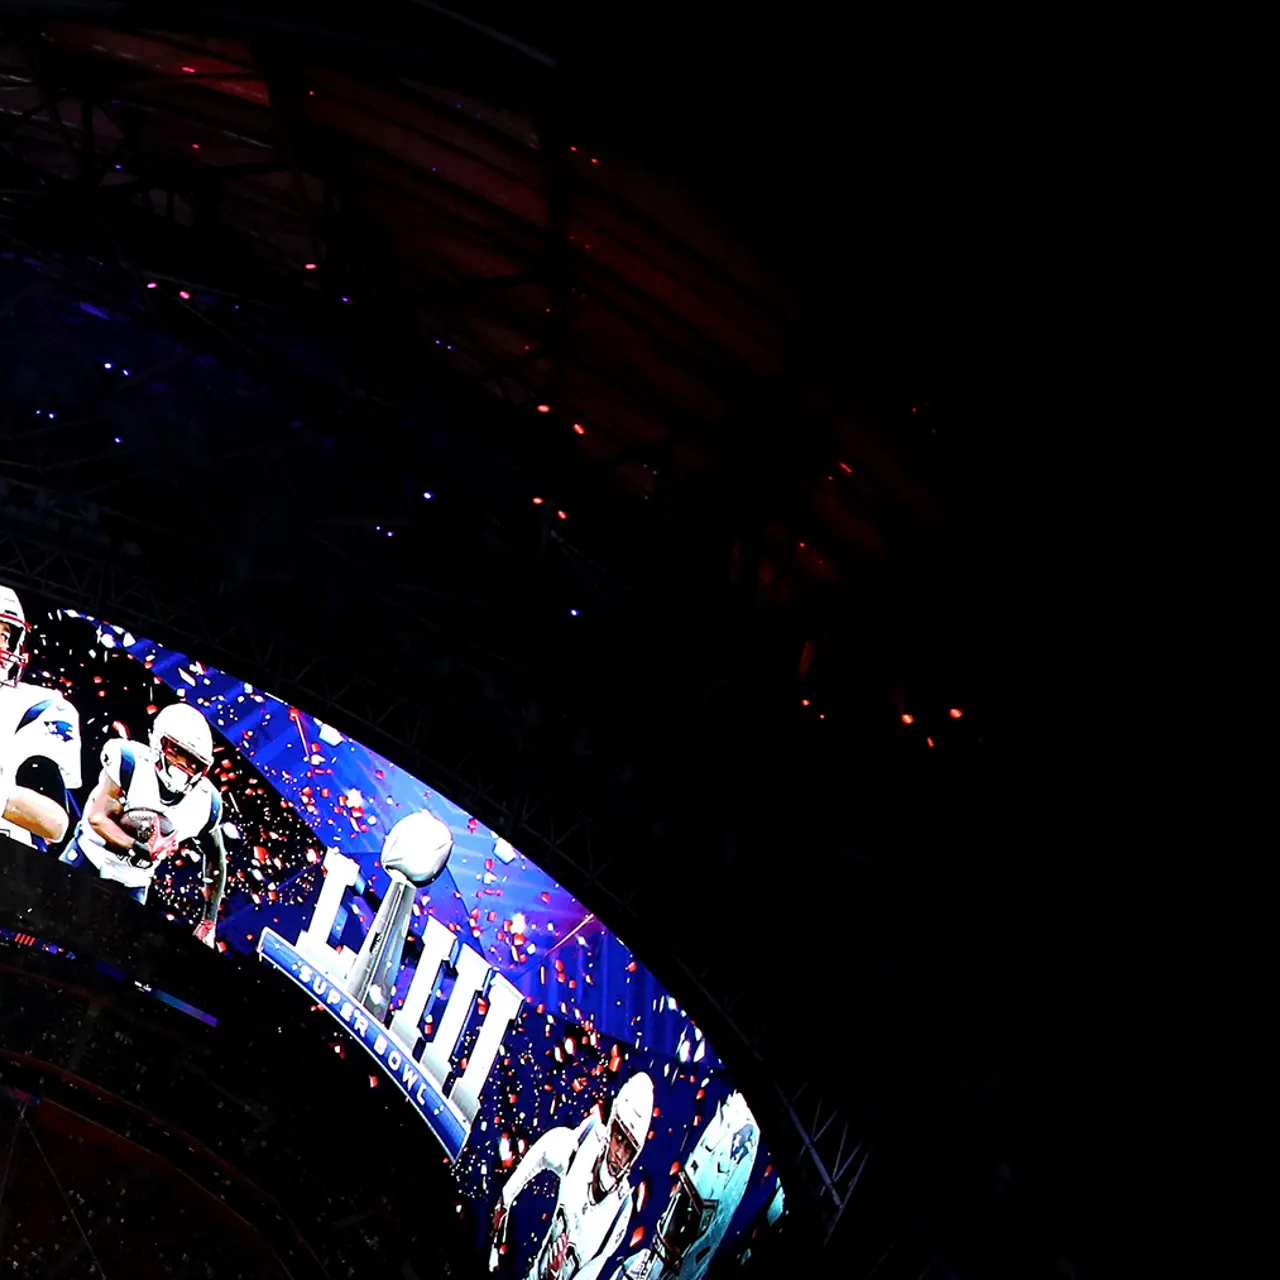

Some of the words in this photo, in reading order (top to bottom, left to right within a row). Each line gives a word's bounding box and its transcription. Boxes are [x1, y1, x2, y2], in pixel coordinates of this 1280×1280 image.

[295, 846, 526, 1129] LIII
[296, 962, 369, 1037] SUPER
[373, 1034, 430, 1104] BOWL
